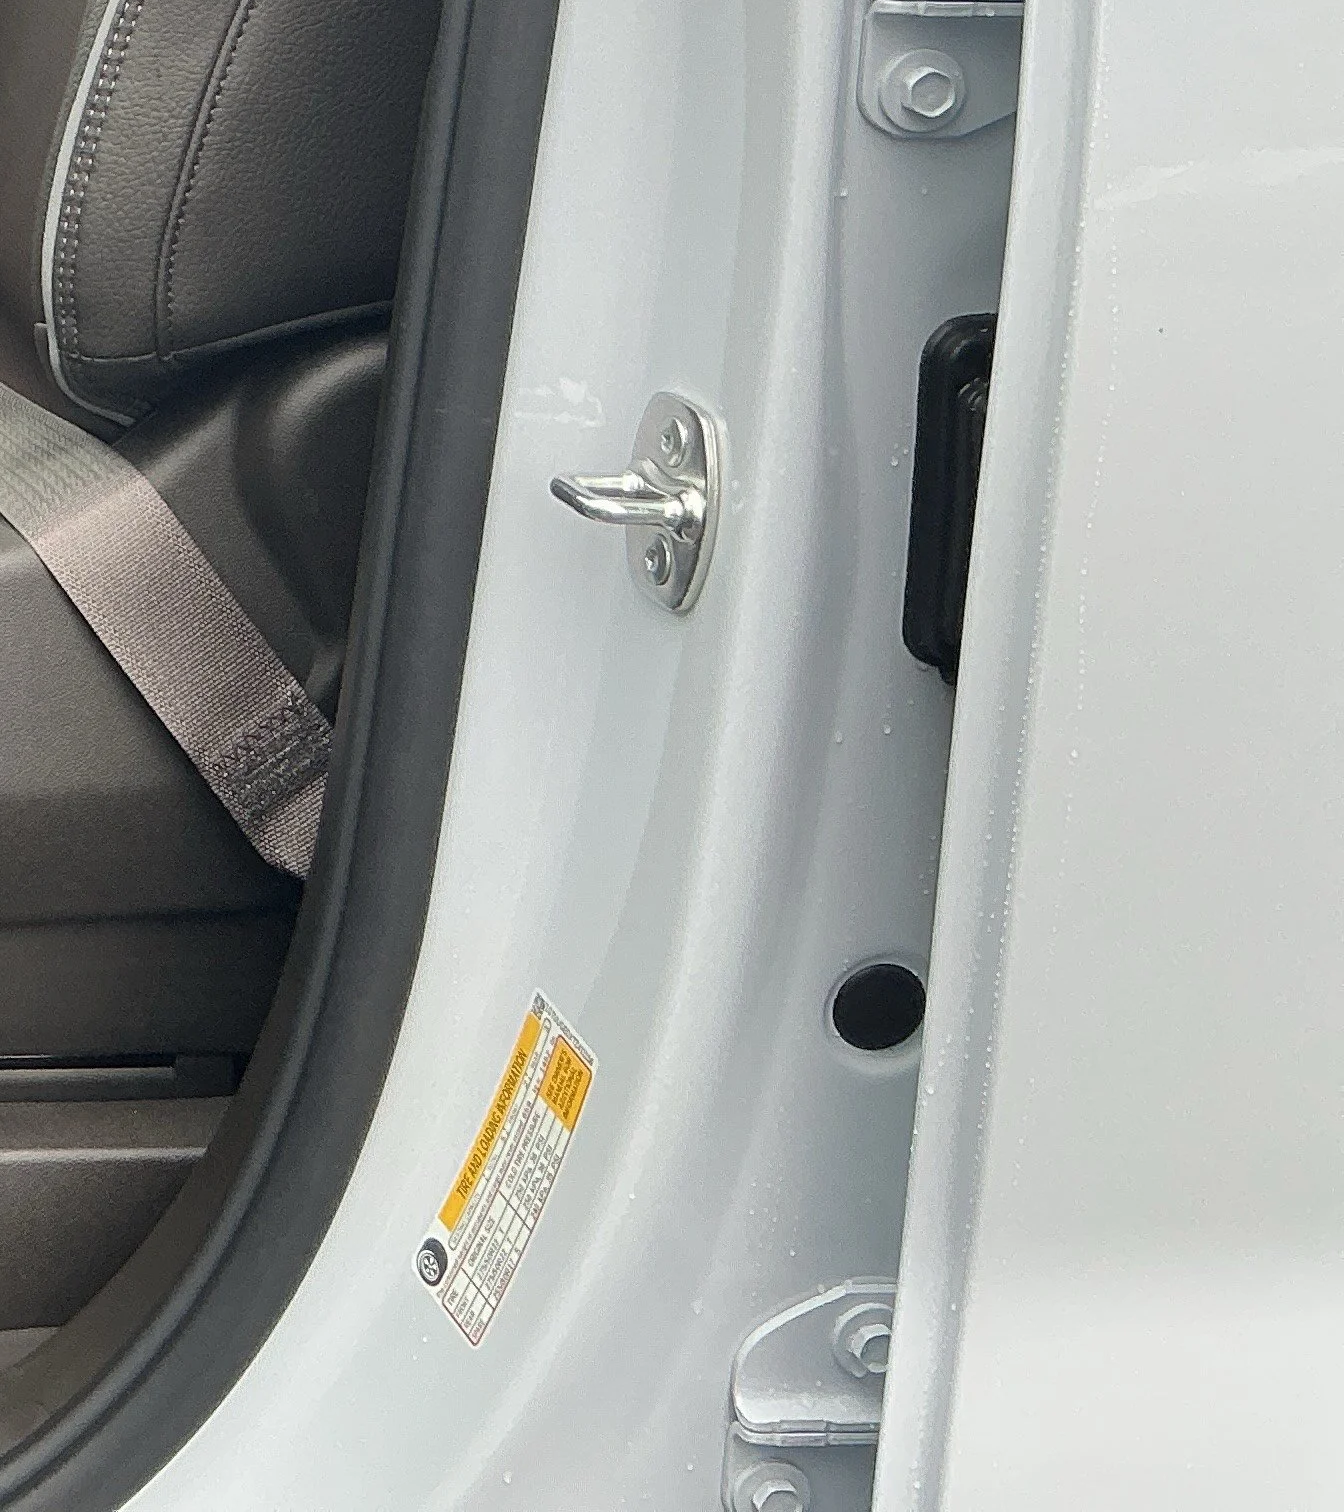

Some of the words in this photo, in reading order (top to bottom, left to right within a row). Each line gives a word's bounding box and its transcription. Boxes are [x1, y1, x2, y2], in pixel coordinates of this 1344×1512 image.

[456, 1173, 472, 1200] TIRE
[467, 1152, 482, 1177] AND
[476, 1110, 501, 1157] LOADING
[495, 1048, 526, 1114] INFORMATION
